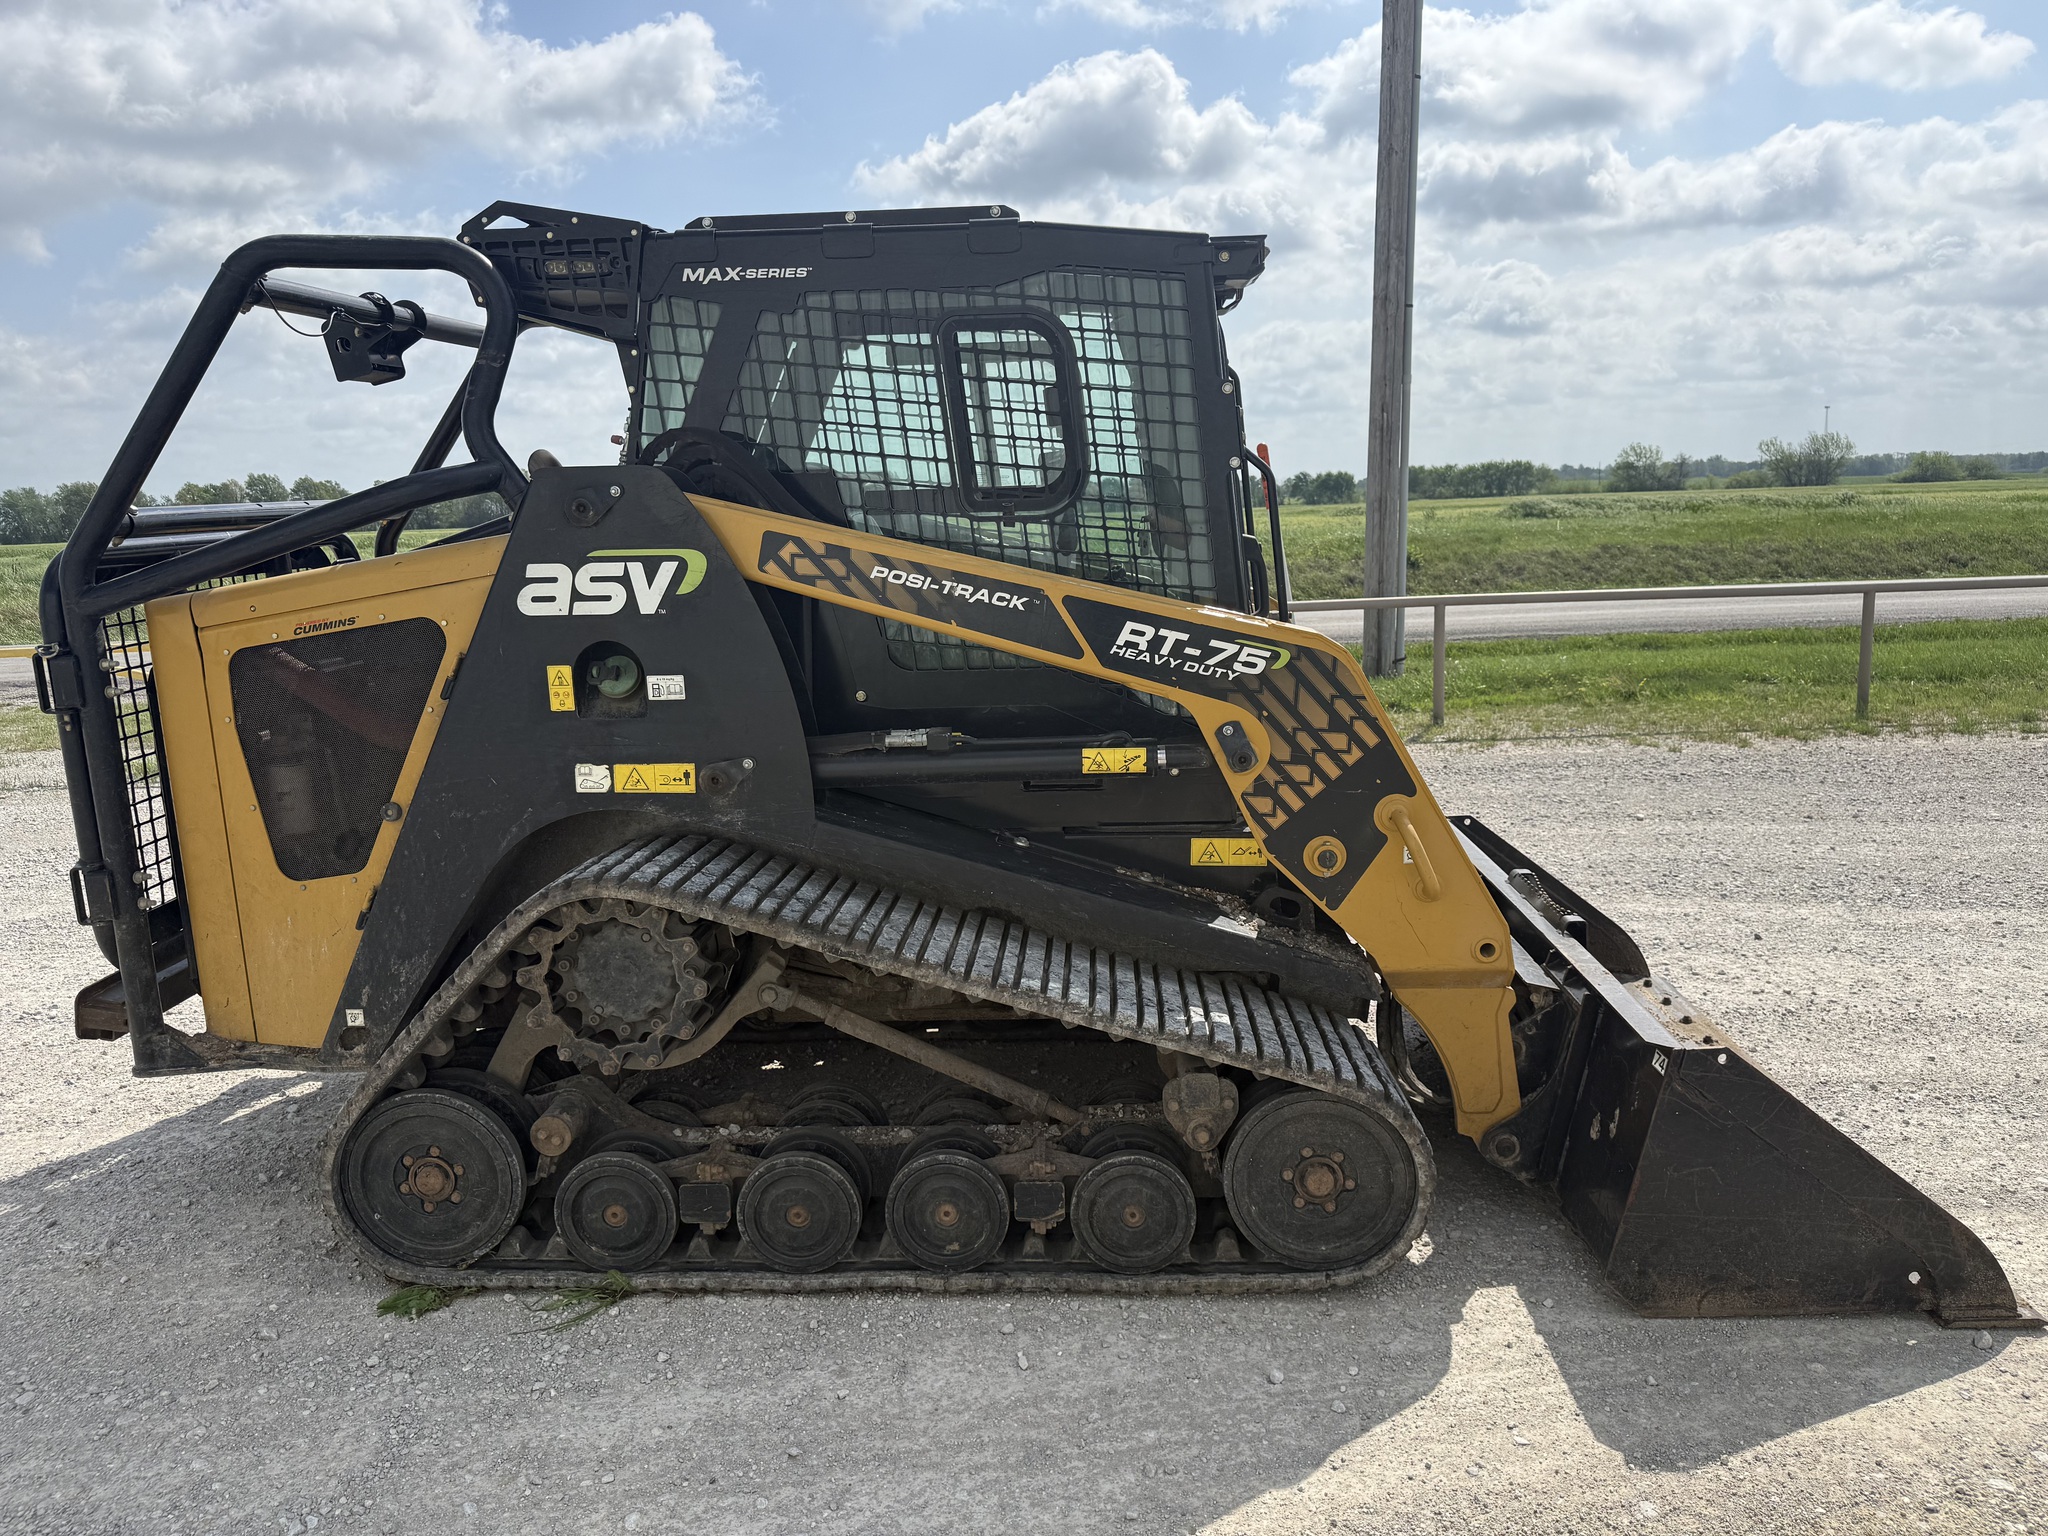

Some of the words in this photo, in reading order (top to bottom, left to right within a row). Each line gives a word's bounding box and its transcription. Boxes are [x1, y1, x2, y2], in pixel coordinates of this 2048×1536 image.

[682, 266, 808, 285] MAX-SERIES
[516, 561, 680, 617] asv
[869, 565, 1030, 611] POSI-TRACK
[293, 616, 357, 636] CUMMINS
[1109, 644, 1183, 668] HEAVY
[1182, 661, 1241, 681] DUTY
[1114, 620, 1272, 675] RT-75
[1653, 1051, 1666, 1073] 74
